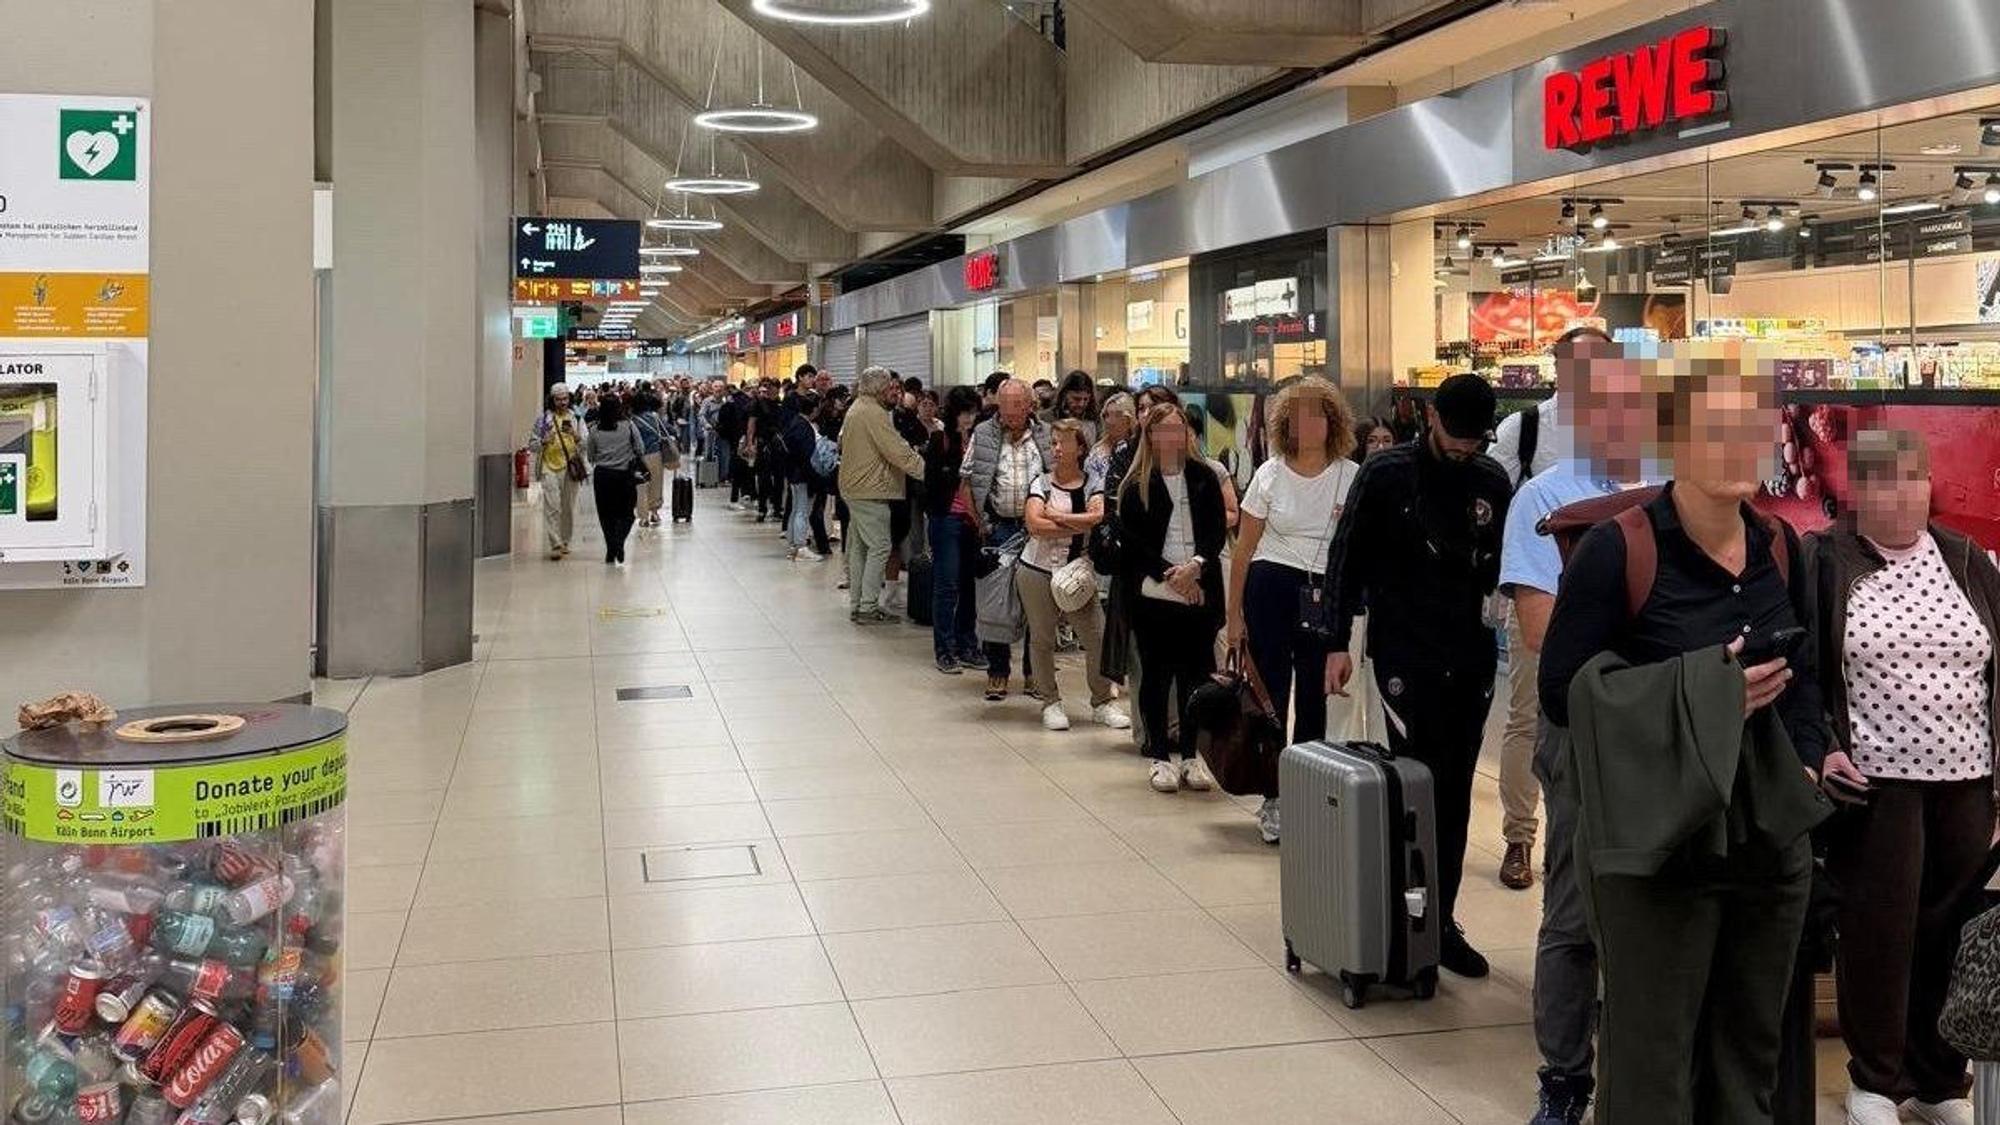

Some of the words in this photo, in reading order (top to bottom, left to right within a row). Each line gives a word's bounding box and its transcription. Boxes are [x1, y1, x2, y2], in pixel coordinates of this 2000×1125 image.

[1544, 25, 1714, 151] REWE
[196, 775, 274, 802] Donate
[282, 765, 318, 792] your
[56, 825, 78, 837] Köln
[80, 826, 107, 838] Bonn
[110, 826, 155, 839] Airport
